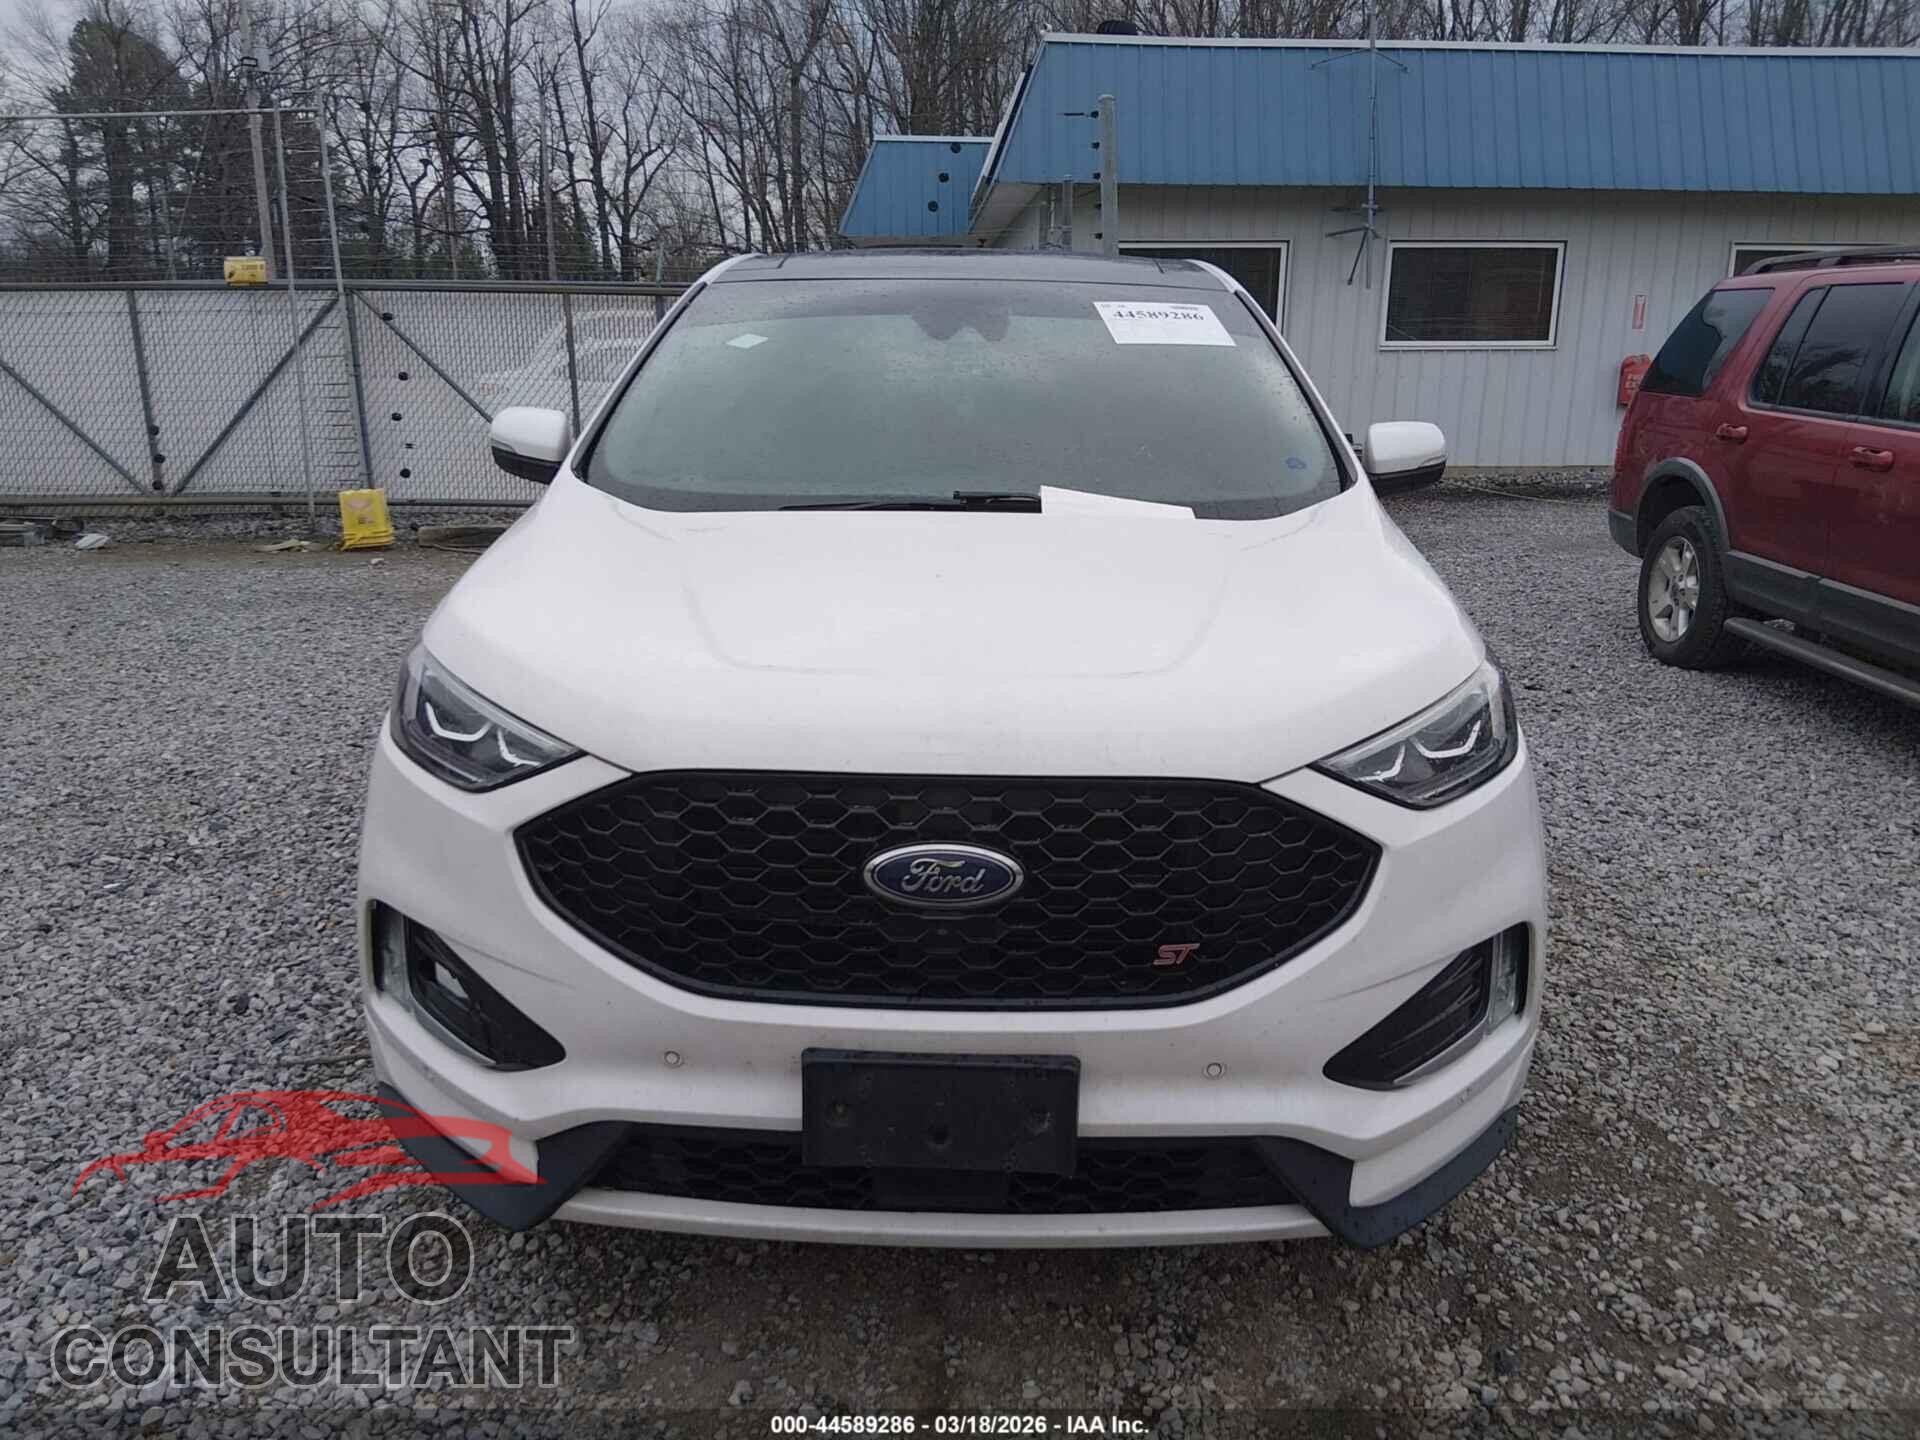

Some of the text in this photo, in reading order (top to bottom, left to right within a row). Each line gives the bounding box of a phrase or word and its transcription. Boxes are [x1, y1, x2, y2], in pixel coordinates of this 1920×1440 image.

[1113, 310, 1204, 321] 44589286
[901, 857, 987, 895] Ford
[1152, 943, 1200, 966] ST
